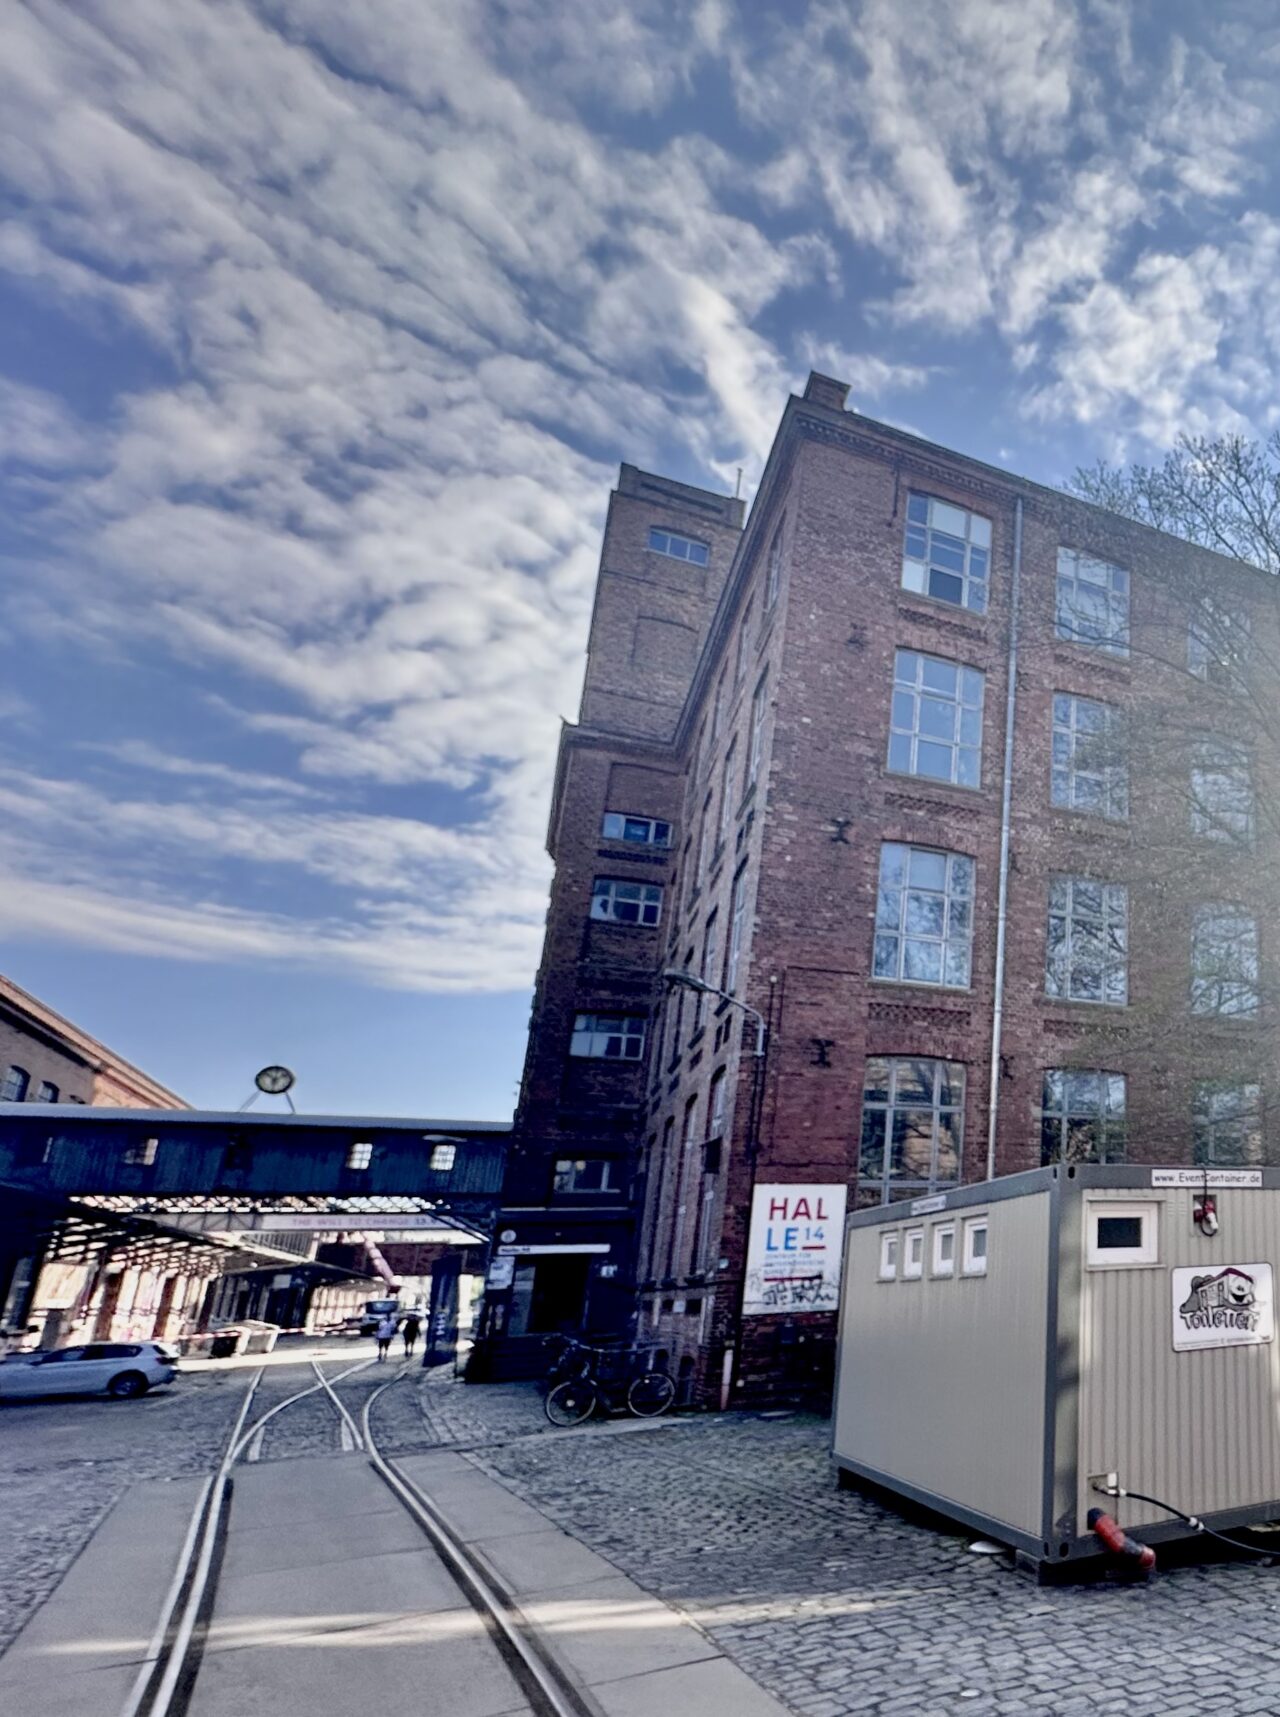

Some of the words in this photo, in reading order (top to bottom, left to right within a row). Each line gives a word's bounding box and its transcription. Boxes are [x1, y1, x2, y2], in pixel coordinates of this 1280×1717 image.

[769, 1197, 829, 1221] HAL
[766, 1227, 799, 1251] LE
[804, 1227, 825, 1240] 14
